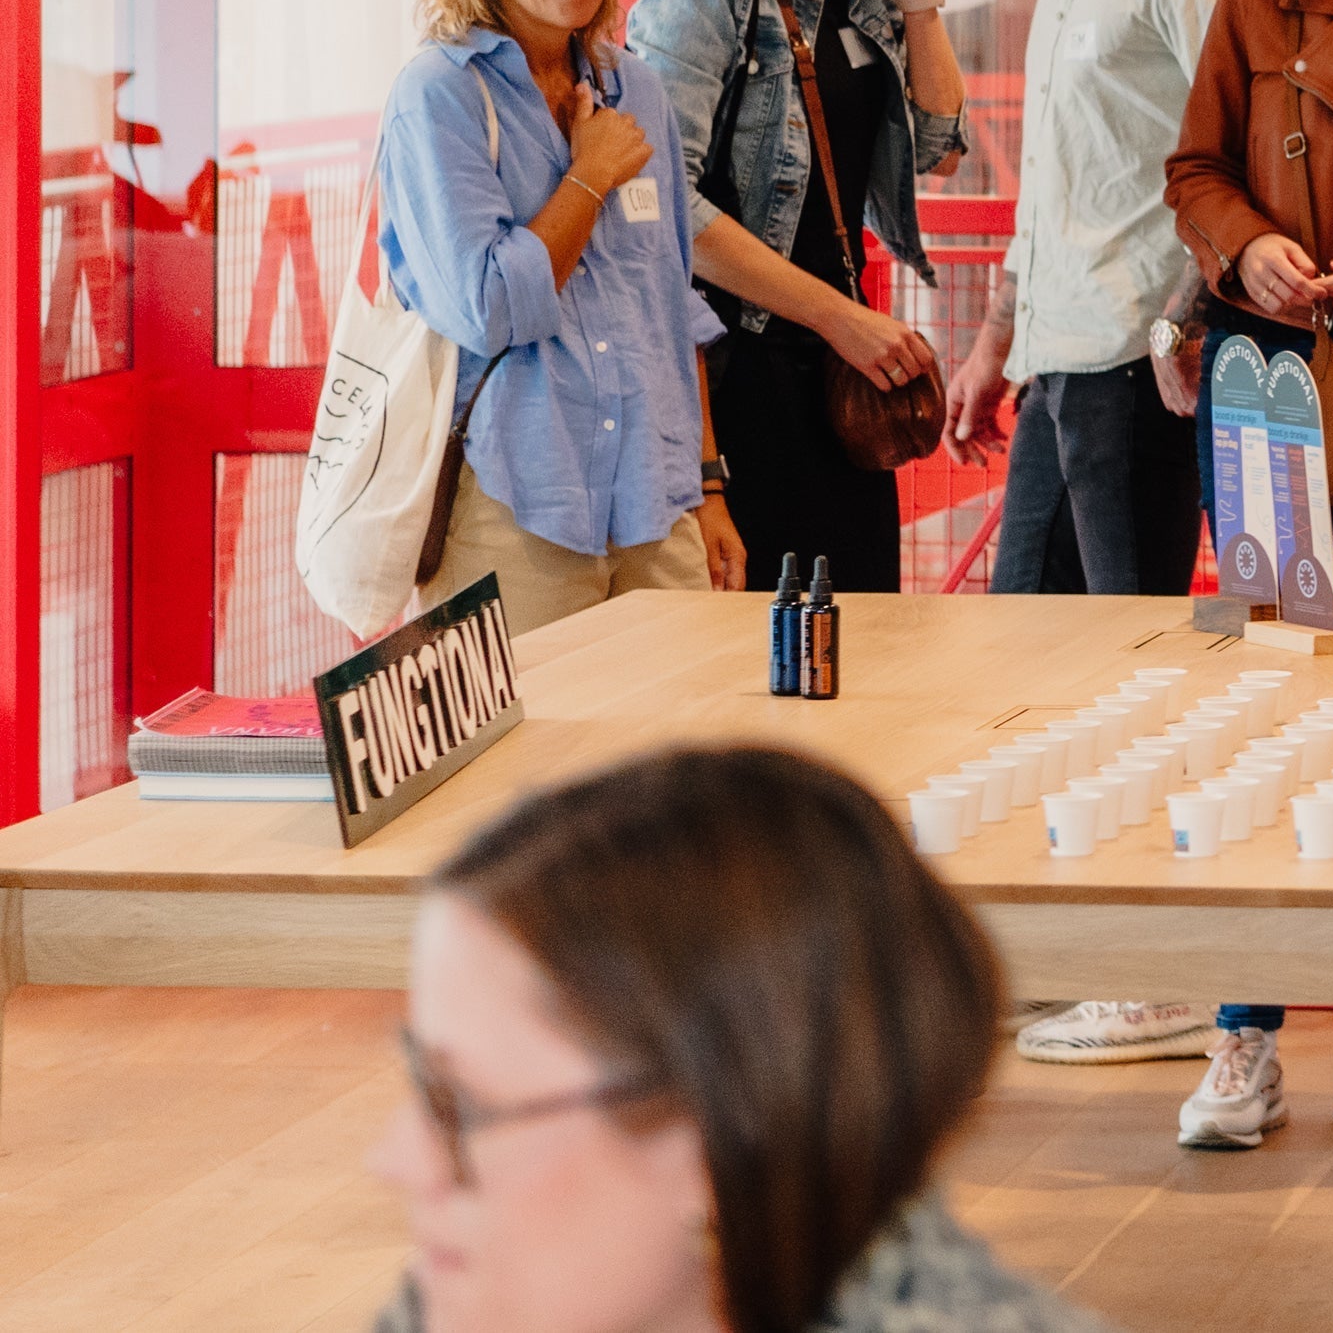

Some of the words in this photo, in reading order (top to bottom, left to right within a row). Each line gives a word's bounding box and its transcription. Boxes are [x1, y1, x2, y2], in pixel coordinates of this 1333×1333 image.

[1216, 345, 1265, 388] FUNGTIONAL
[1267, 361, 1314, 406] FUNGTIONAL
[338, 598, 522, 814] FUNGTIONAL
